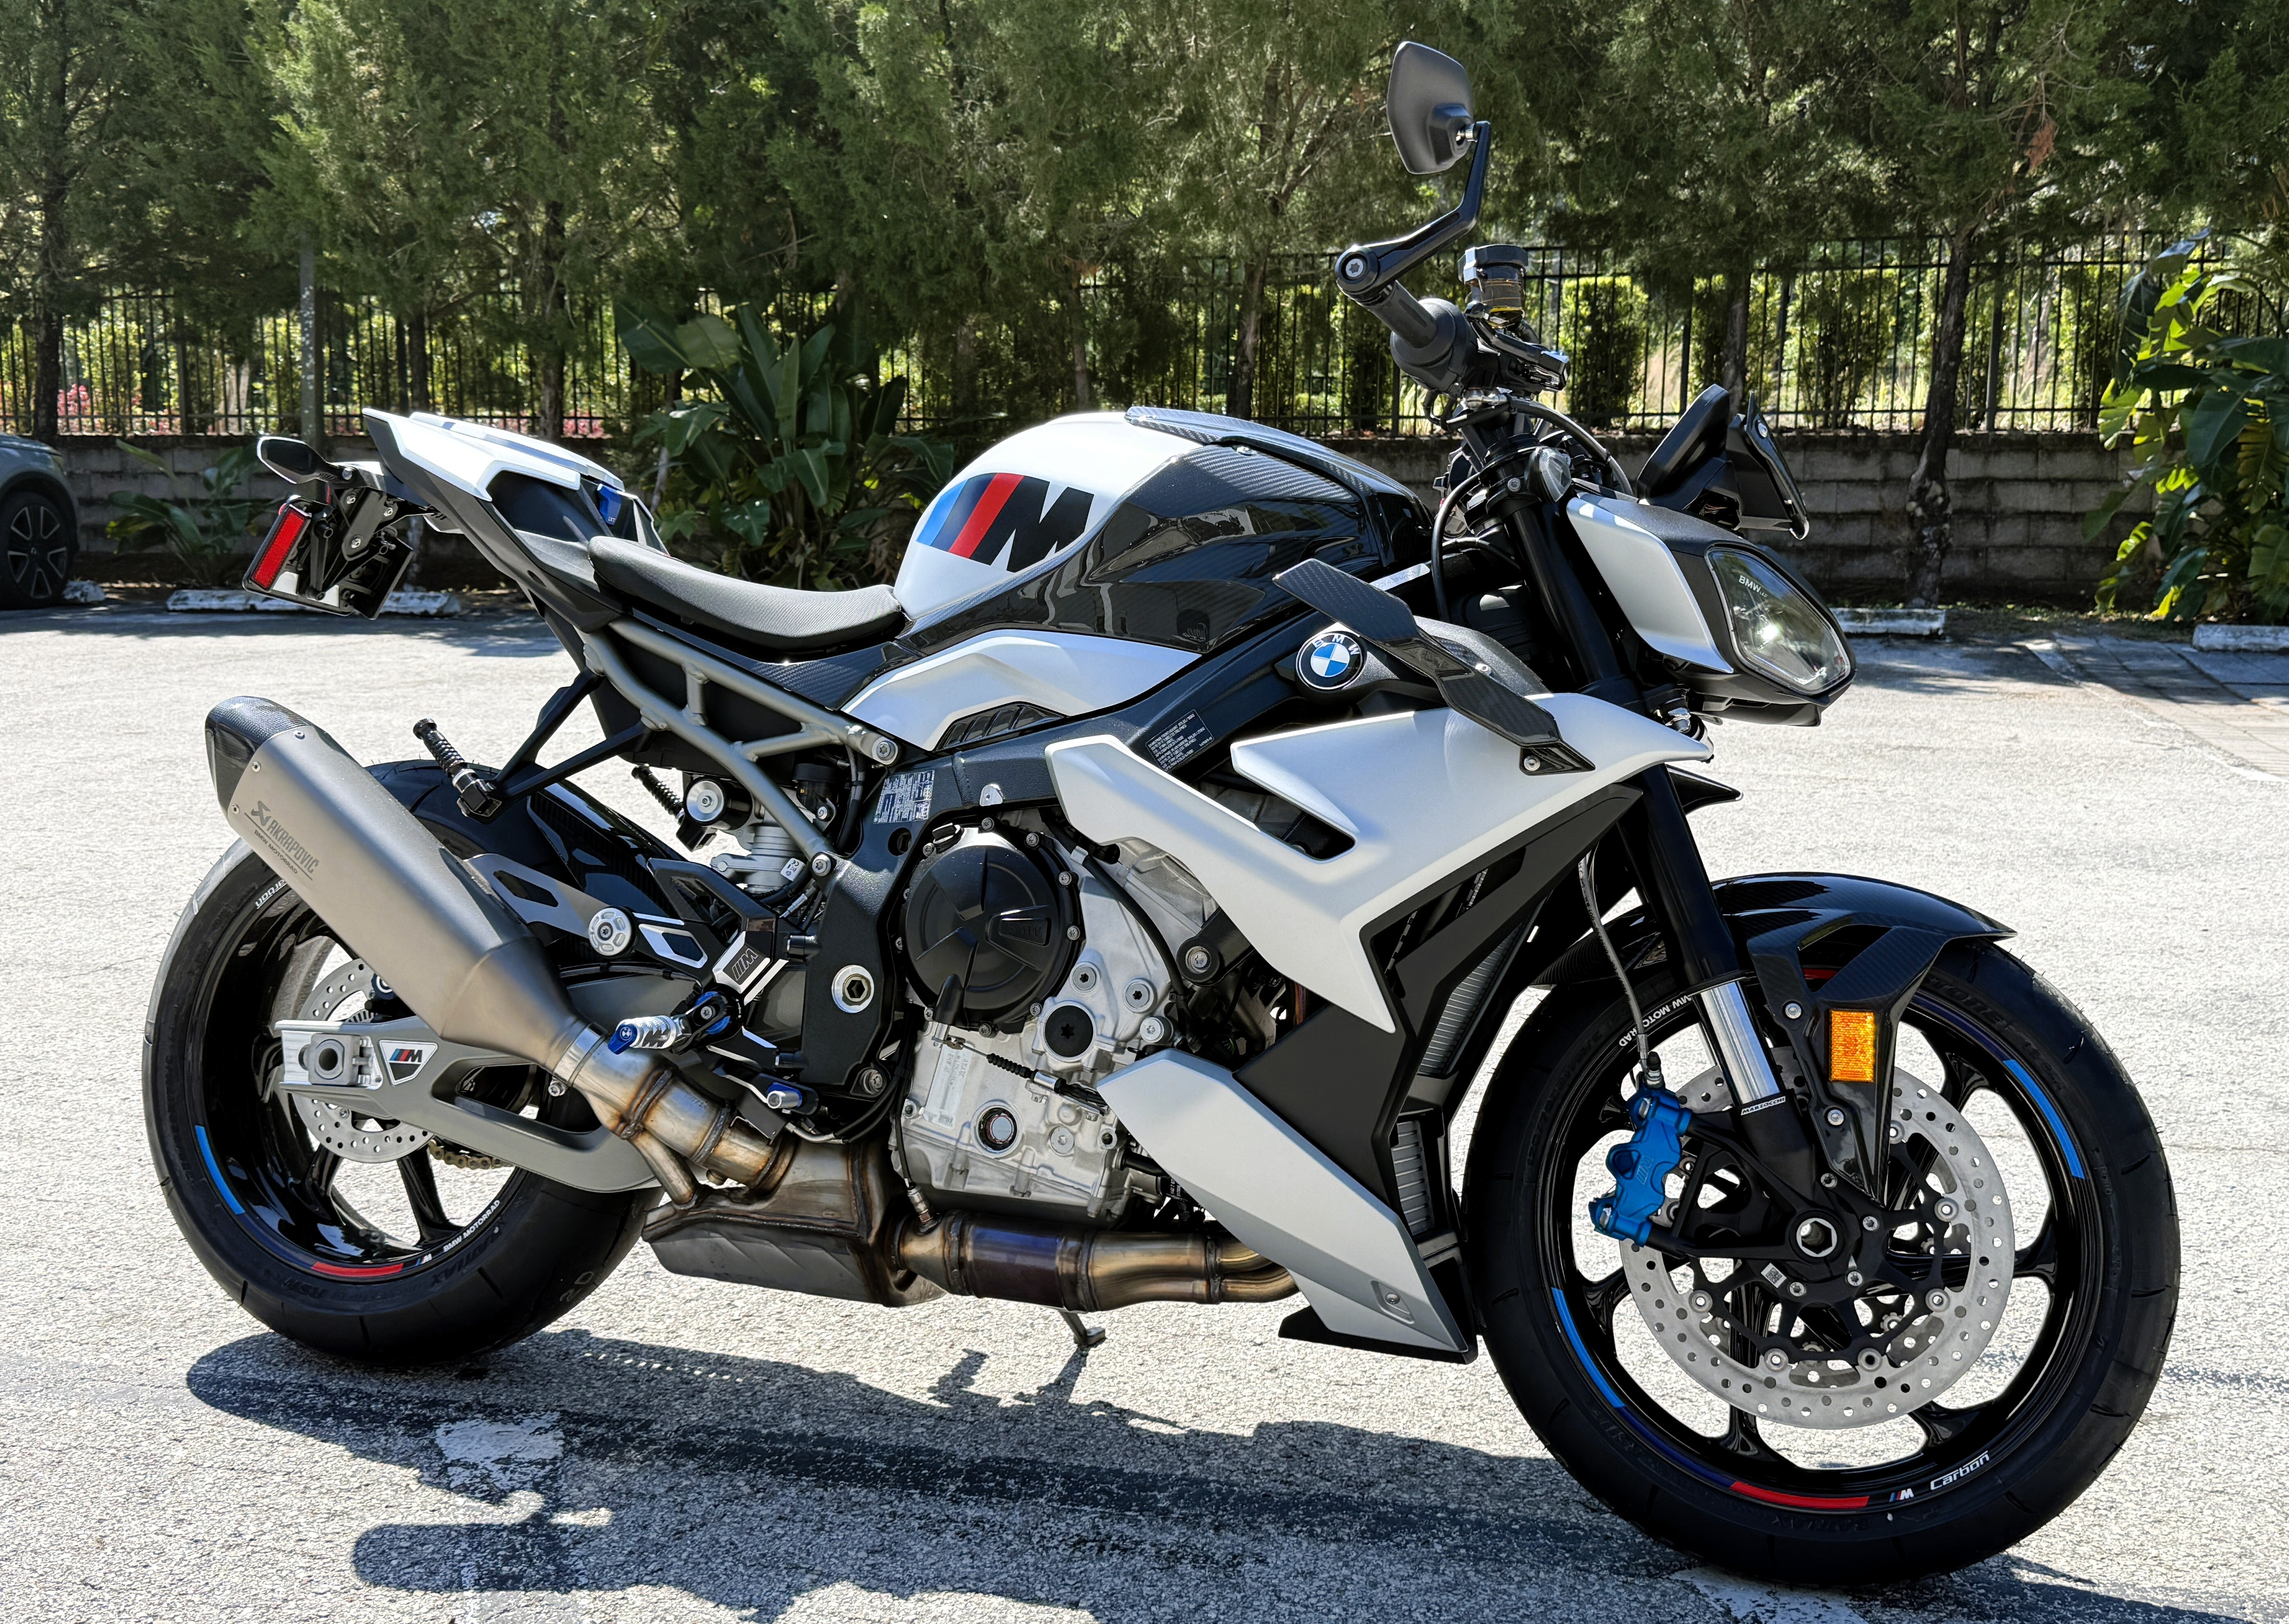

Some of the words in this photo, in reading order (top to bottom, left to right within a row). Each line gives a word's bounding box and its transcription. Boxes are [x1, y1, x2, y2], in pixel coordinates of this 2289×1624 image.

[969, 475, 1095, 573] M
[1739, 575, 1761, 593] BMW
[1312, 634, 1360, 655] BMW
[254, 830, 269, 846] BMW
[269, 843, 298, 874] MOTORRAD
[255, 879, 286, 909] arbon
[1672, 995, 1692, 1009] MW
[1619, 1005, 1670, 1047] MOTORAD
[1742, 1097, 1785, 1114] MARZOCCHI
[443, 1235, 463, 1253] BMW
[463, 1200, 500, 1238] MOTORRAD
[1930, 1451, 1990, 1491] Carbon
